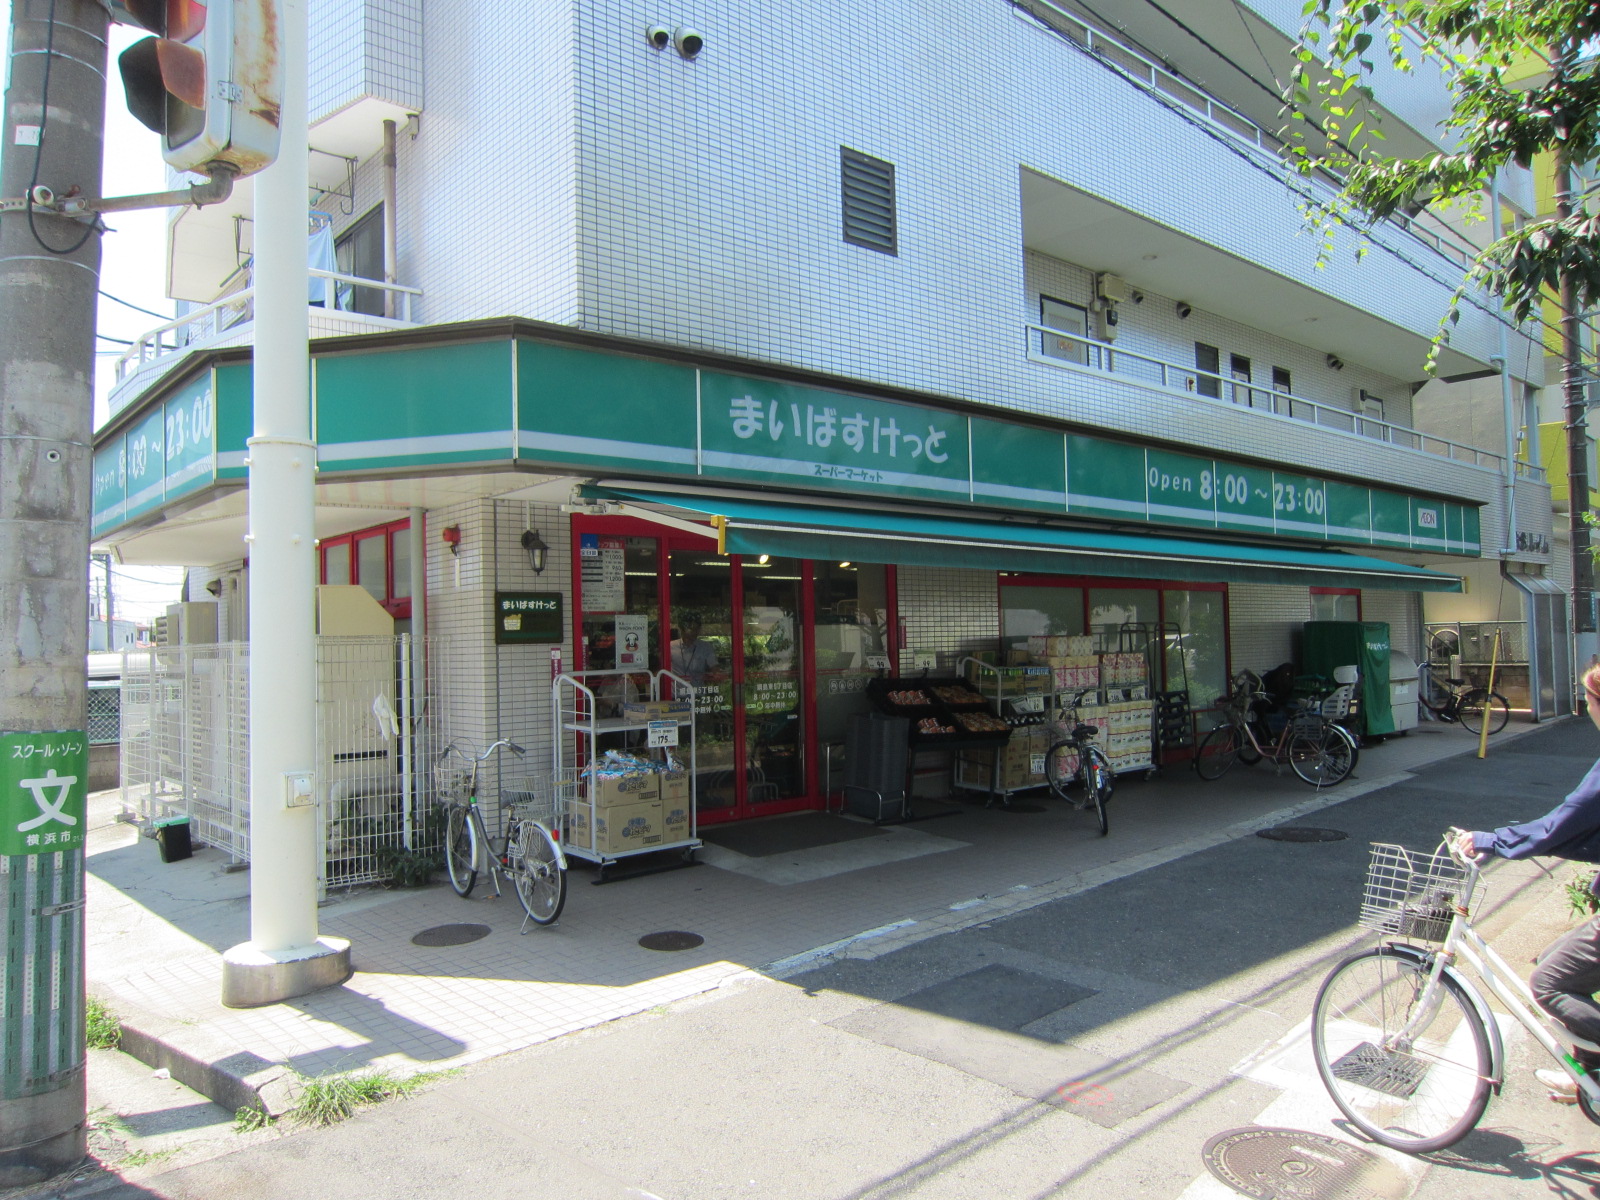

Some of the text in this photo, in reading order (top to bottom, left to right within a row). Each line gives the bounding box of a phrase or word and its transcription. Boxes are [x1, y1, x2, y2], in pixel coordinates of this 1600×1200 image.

[729, 394, 949, 464] まいばすけっと
[95, 469, 115, 496] Open
[814, 464, 883, 483] スーパーマーケット
[1149, 467, 1192, 492] Open
[502, 600, 557, 610] まいばすけっと
[657, 734, 669, 744] 175
[12, 742, 82, 758] スクール・ゾーン
[17, 769, 78, 832] 文
[26, 831, 71, 846] 横浜市
